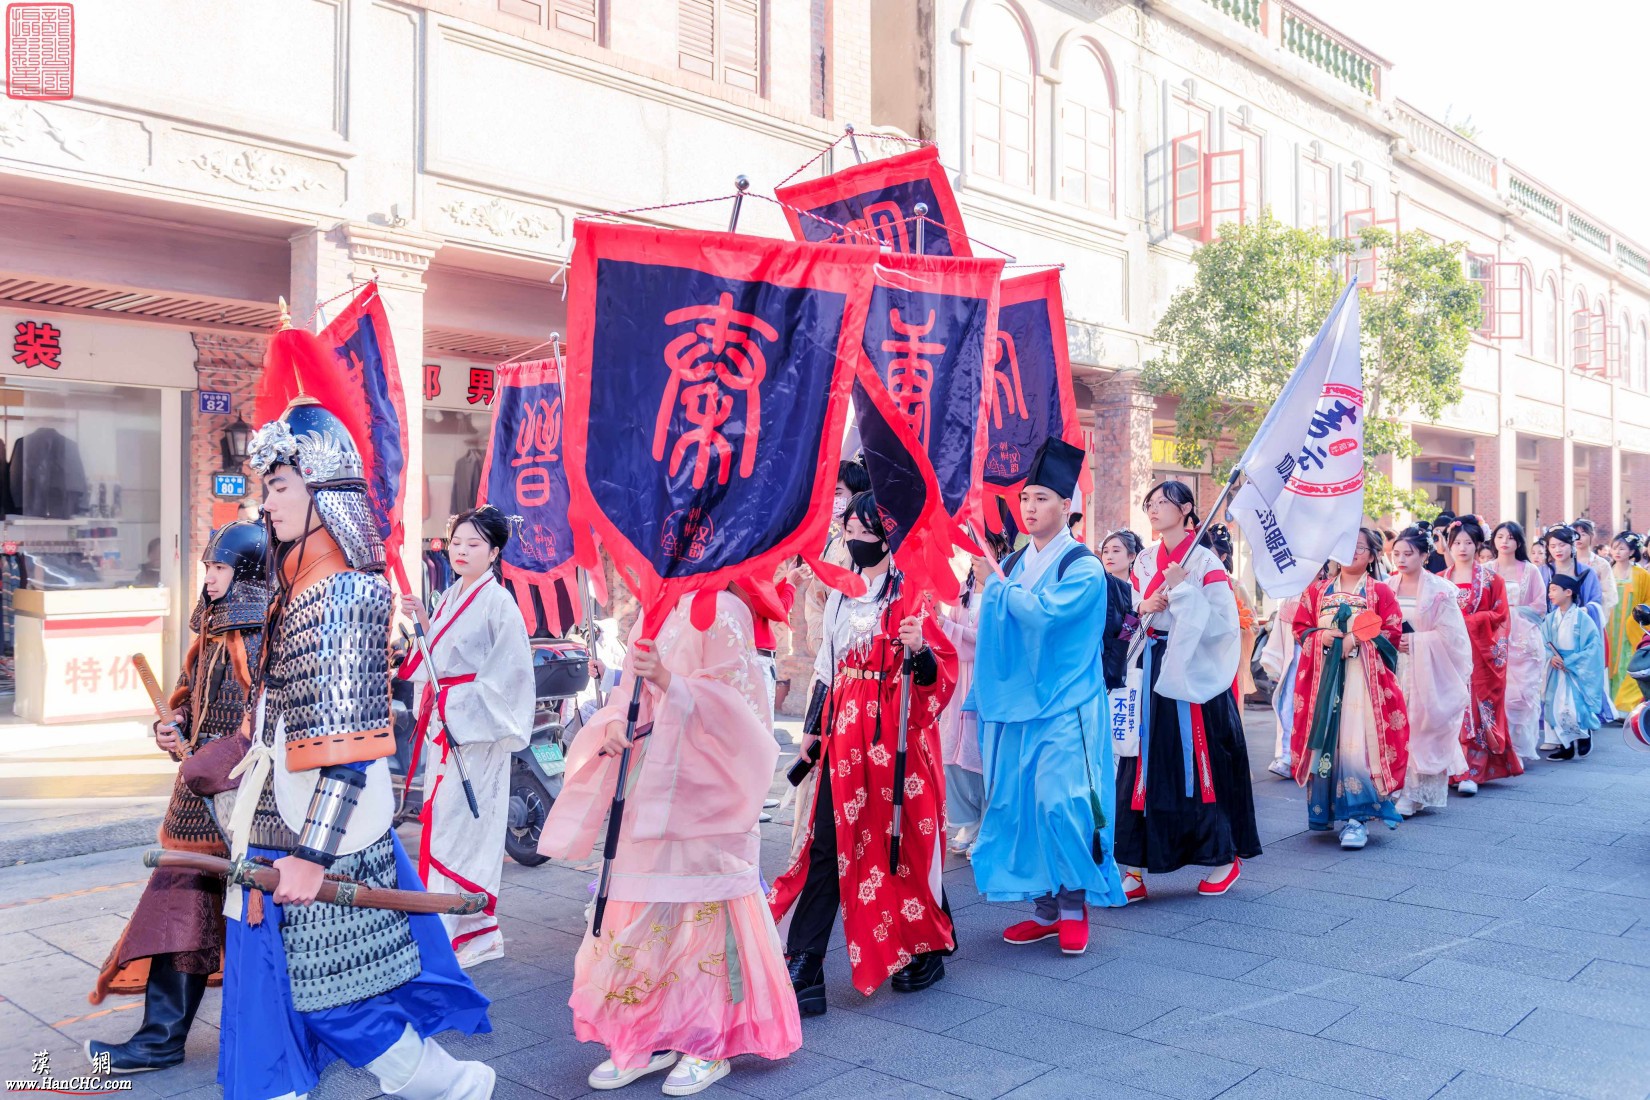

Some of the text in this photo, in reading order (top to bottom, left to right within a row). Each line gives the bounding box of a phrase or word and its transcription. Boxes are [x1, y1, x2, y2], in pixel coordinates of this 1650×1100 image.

[12, 321, 62, 370] 装
[206, 400, 225, 411] 82
[221, 483, 234, 494] 80
[65, 655, 137, 694] 特价
[1113, 697, 1127, 740] 不存在
